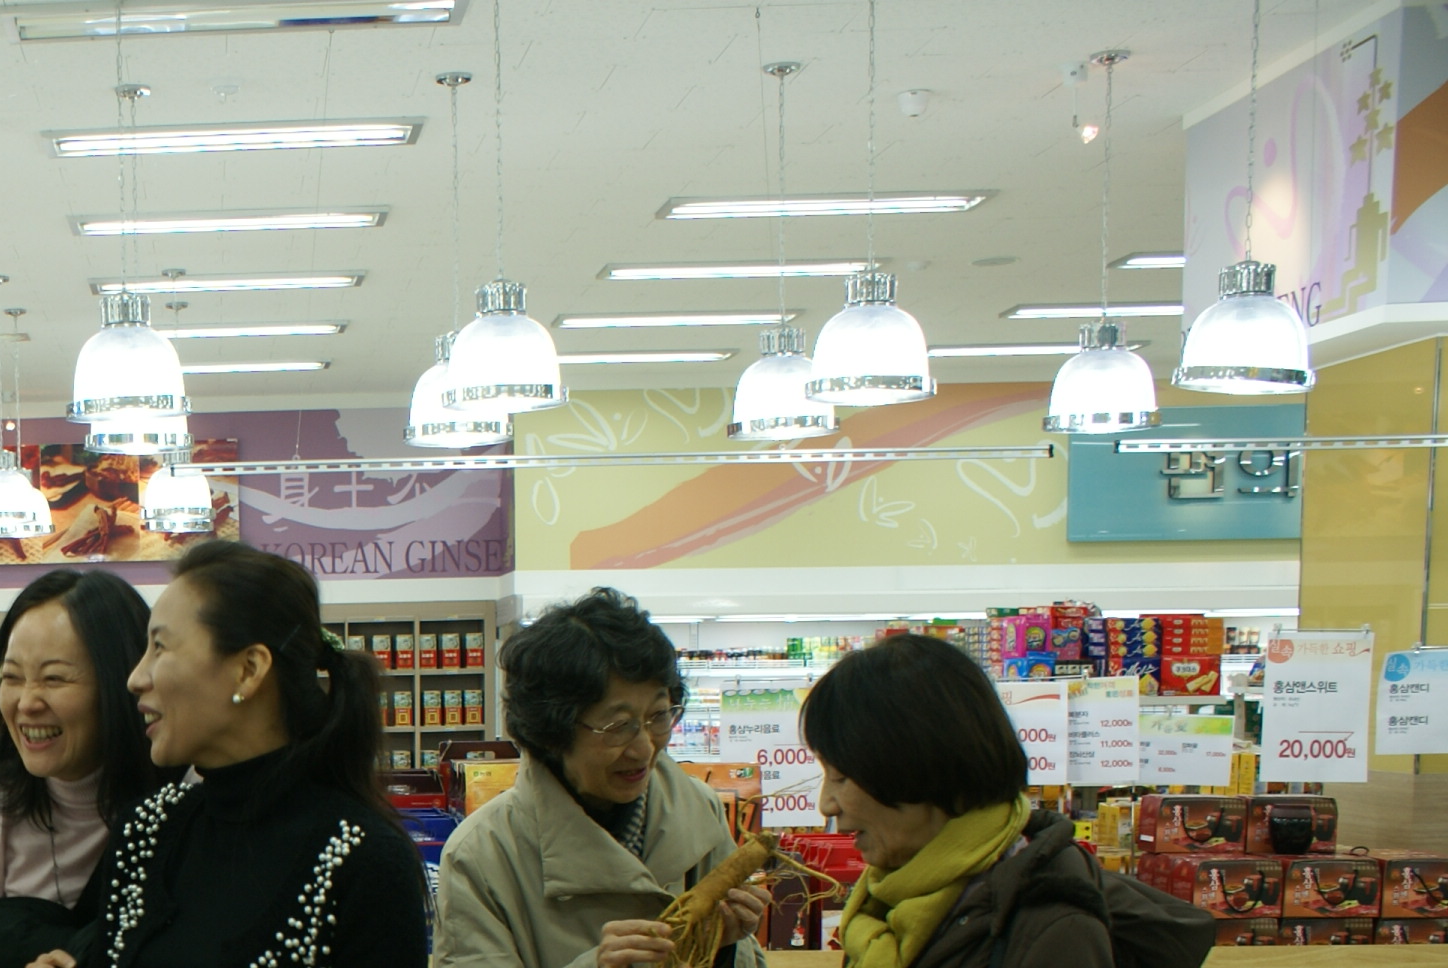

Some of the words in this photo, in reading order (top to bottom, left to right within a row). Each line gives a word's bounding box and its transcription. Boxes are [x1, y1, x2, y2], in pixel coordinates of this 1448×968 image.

[1332, 641, 1357, 657] 쇼핑
[1273, 680, 1338, 694] 홍삼앤스위트
[1389, 683, 1430, 694] 홍삼캔디
[1388, 714, 1429, 727] 홍삼캔디
[728, 724, 780, 735] 홍삼누리음료
[1278, 739, 1356, 760] 20,000원
[757, 748, 815, 766] 6,000원
